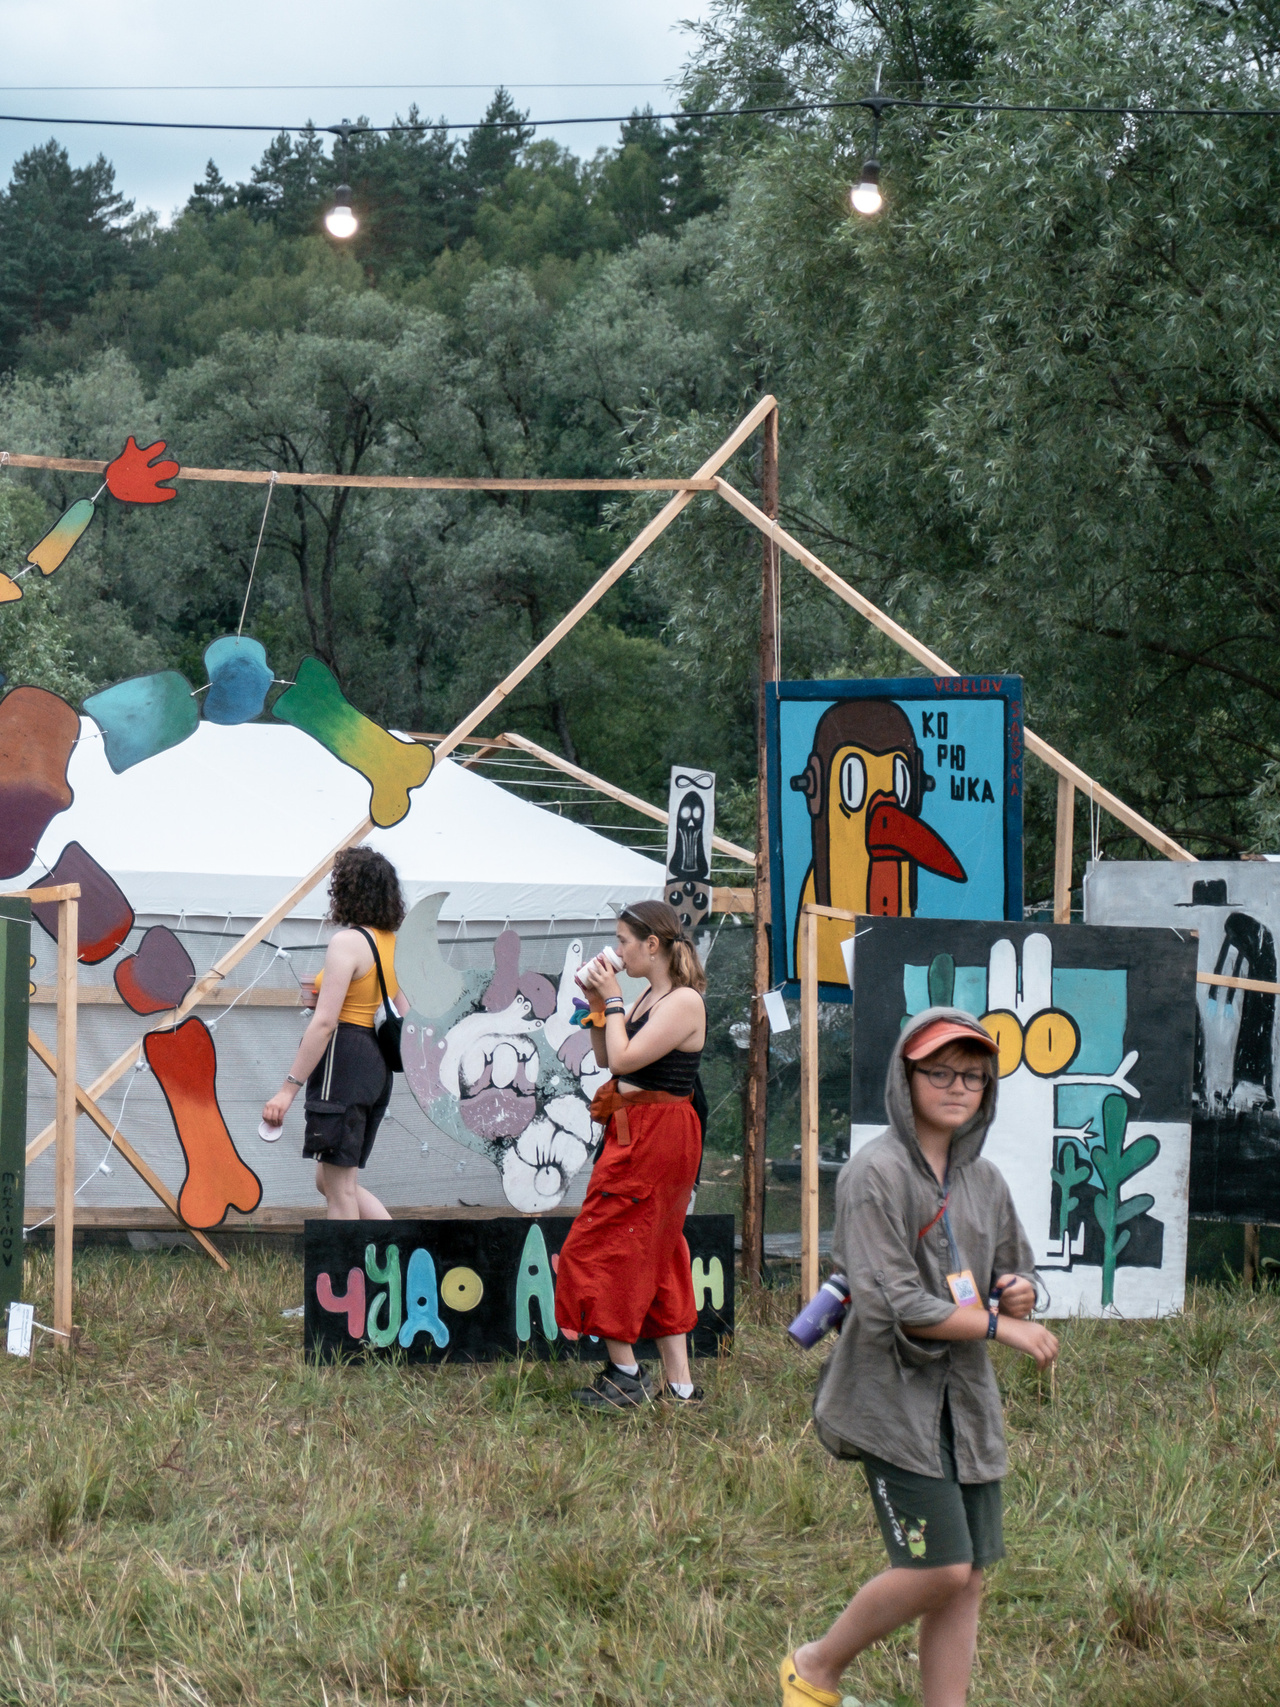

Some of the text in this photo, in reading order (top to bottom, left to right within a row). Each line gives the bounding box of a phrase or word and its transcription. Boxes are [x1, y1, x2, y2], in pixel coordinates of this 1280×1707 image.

[933, 678, 1002, 693] VESELOV
[922, 711, 948, 740] КО
[937, 744, 965, 771] РЮ
[950, 775, 995, 803] ШКА
[316, 1243, 484, 1348] ЧУДО
